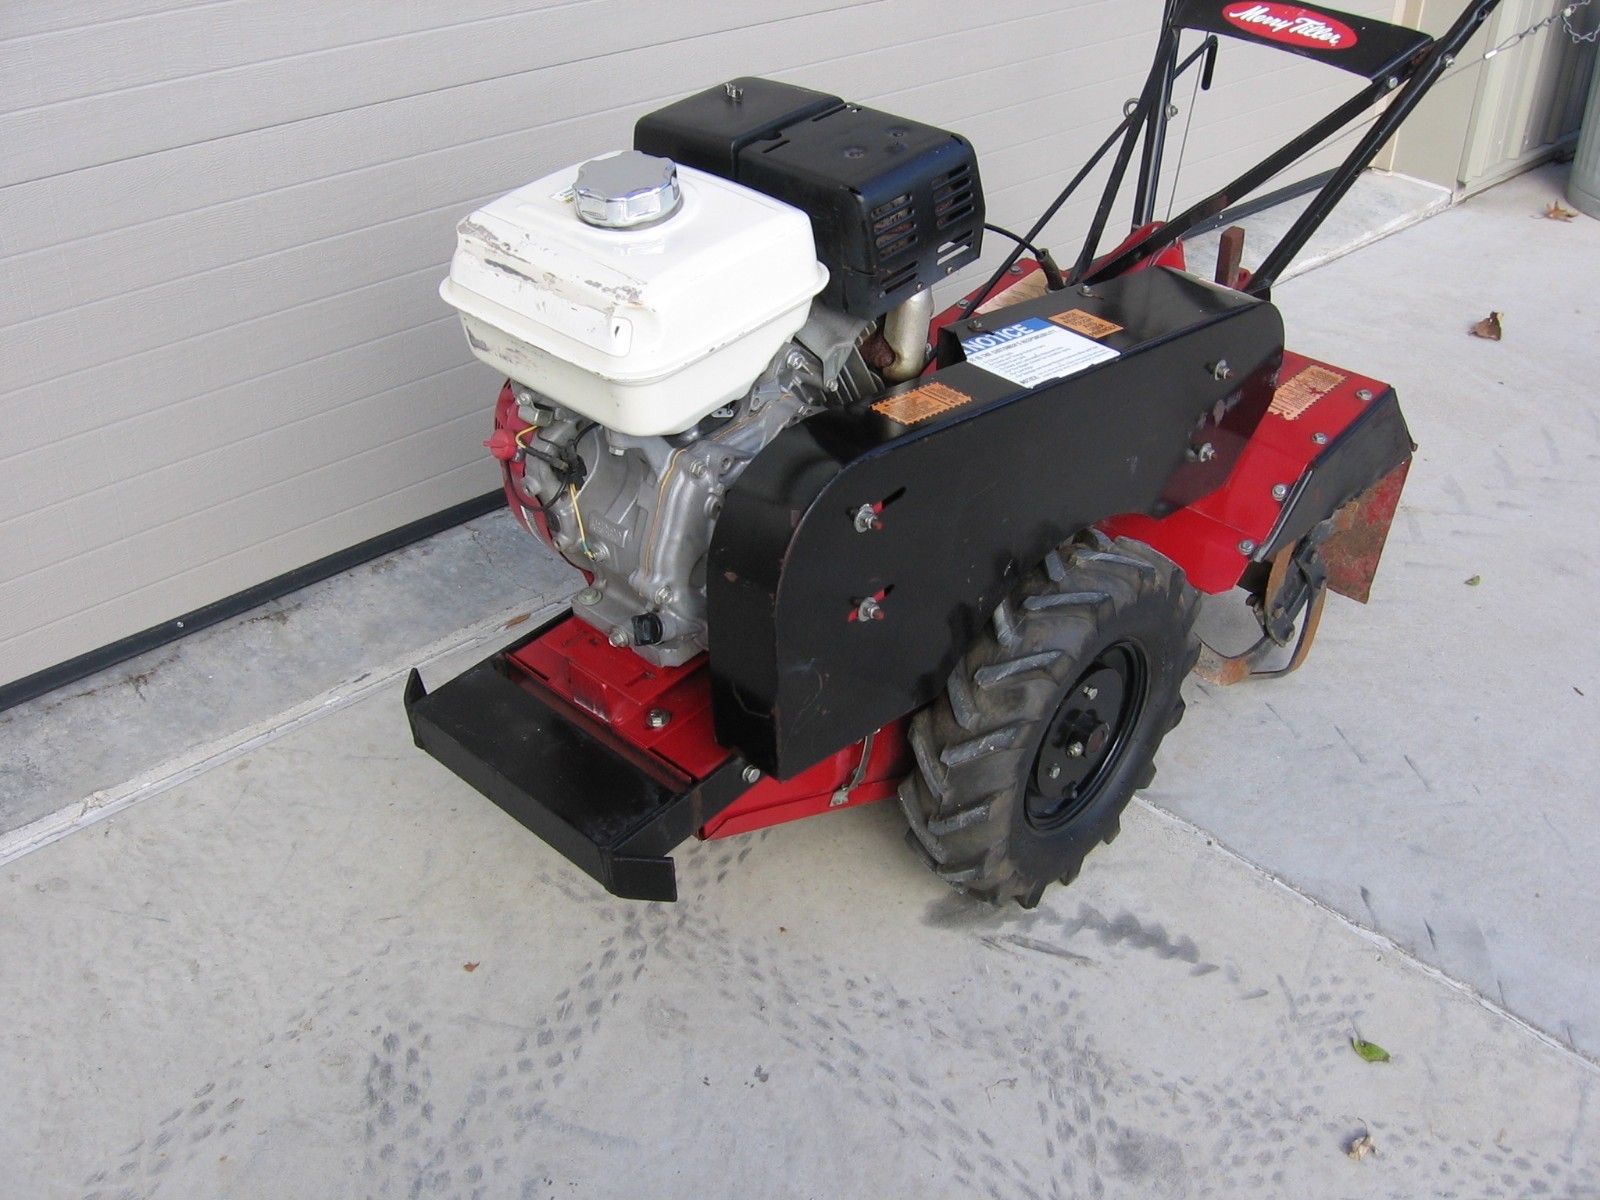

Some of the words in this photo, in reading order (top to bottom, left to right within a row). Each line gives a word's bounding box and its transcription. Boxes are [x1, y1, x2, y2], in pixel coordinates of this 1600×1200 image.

[1229, 5, 1294, 32] Merry
[1288, 17, 1341, 45] Tiller
[961, 324, 1034, 351] NOTICE
